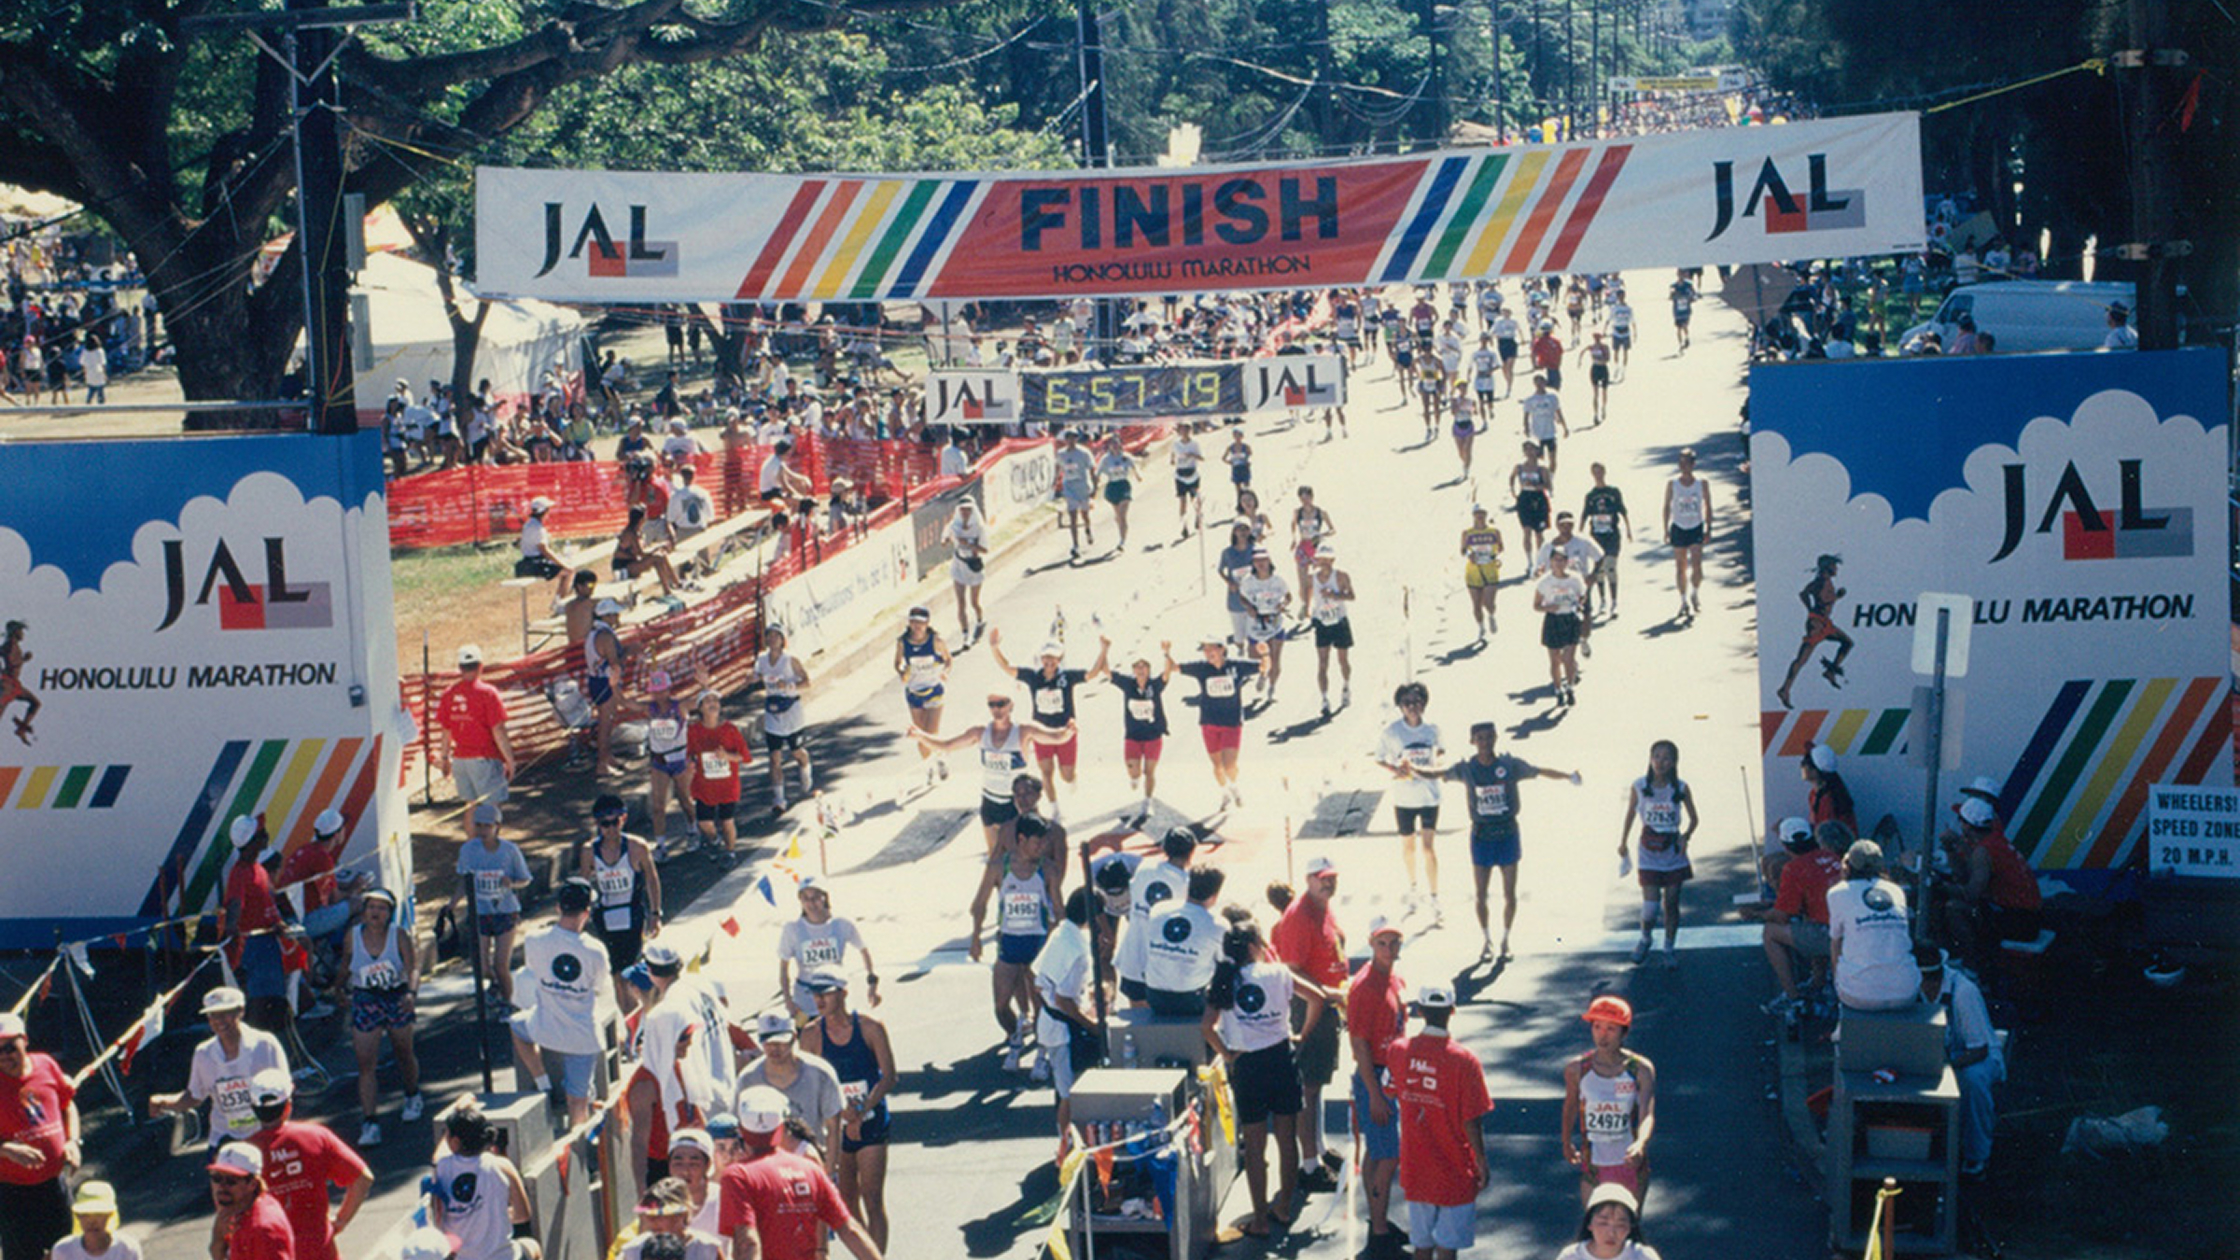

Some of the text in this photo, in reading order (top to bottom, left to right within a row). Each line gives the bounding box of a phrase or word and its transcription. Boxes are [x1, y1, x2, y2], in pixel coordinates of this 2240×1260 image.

[1704, 153, 1850, 243] JAL
[1021, 177, 1338, 251] FINISH
[534, 202, 667, 279] JAL
[1053, 255, 1311, 283] HONOLULU MARATHON
[935, 378, 1004, 421] JAL
[1256, 364, 1327, 410] JAL
[1988, 459, 2169, 565] JAL
[155, 536, 311, 633] JAL
[1853, 599, 2010, 628] HONLU
[39, 667, 177, 691] HONOLULU
[2156, 792, 2238, 812] WHEELERS!
[2152, 818, 2240, 839] SPEED ZONE
[2162, 846, 2234, 866] 20 M.P.H.
[1013, 894, 1031, 903] JAL
[809, 939, 831, 950] JAL
[368, 963, 390, 976] JAL
[225, 1079, 249, 1092] JAL
[1595, 1103, 1623, 1113] JAL
